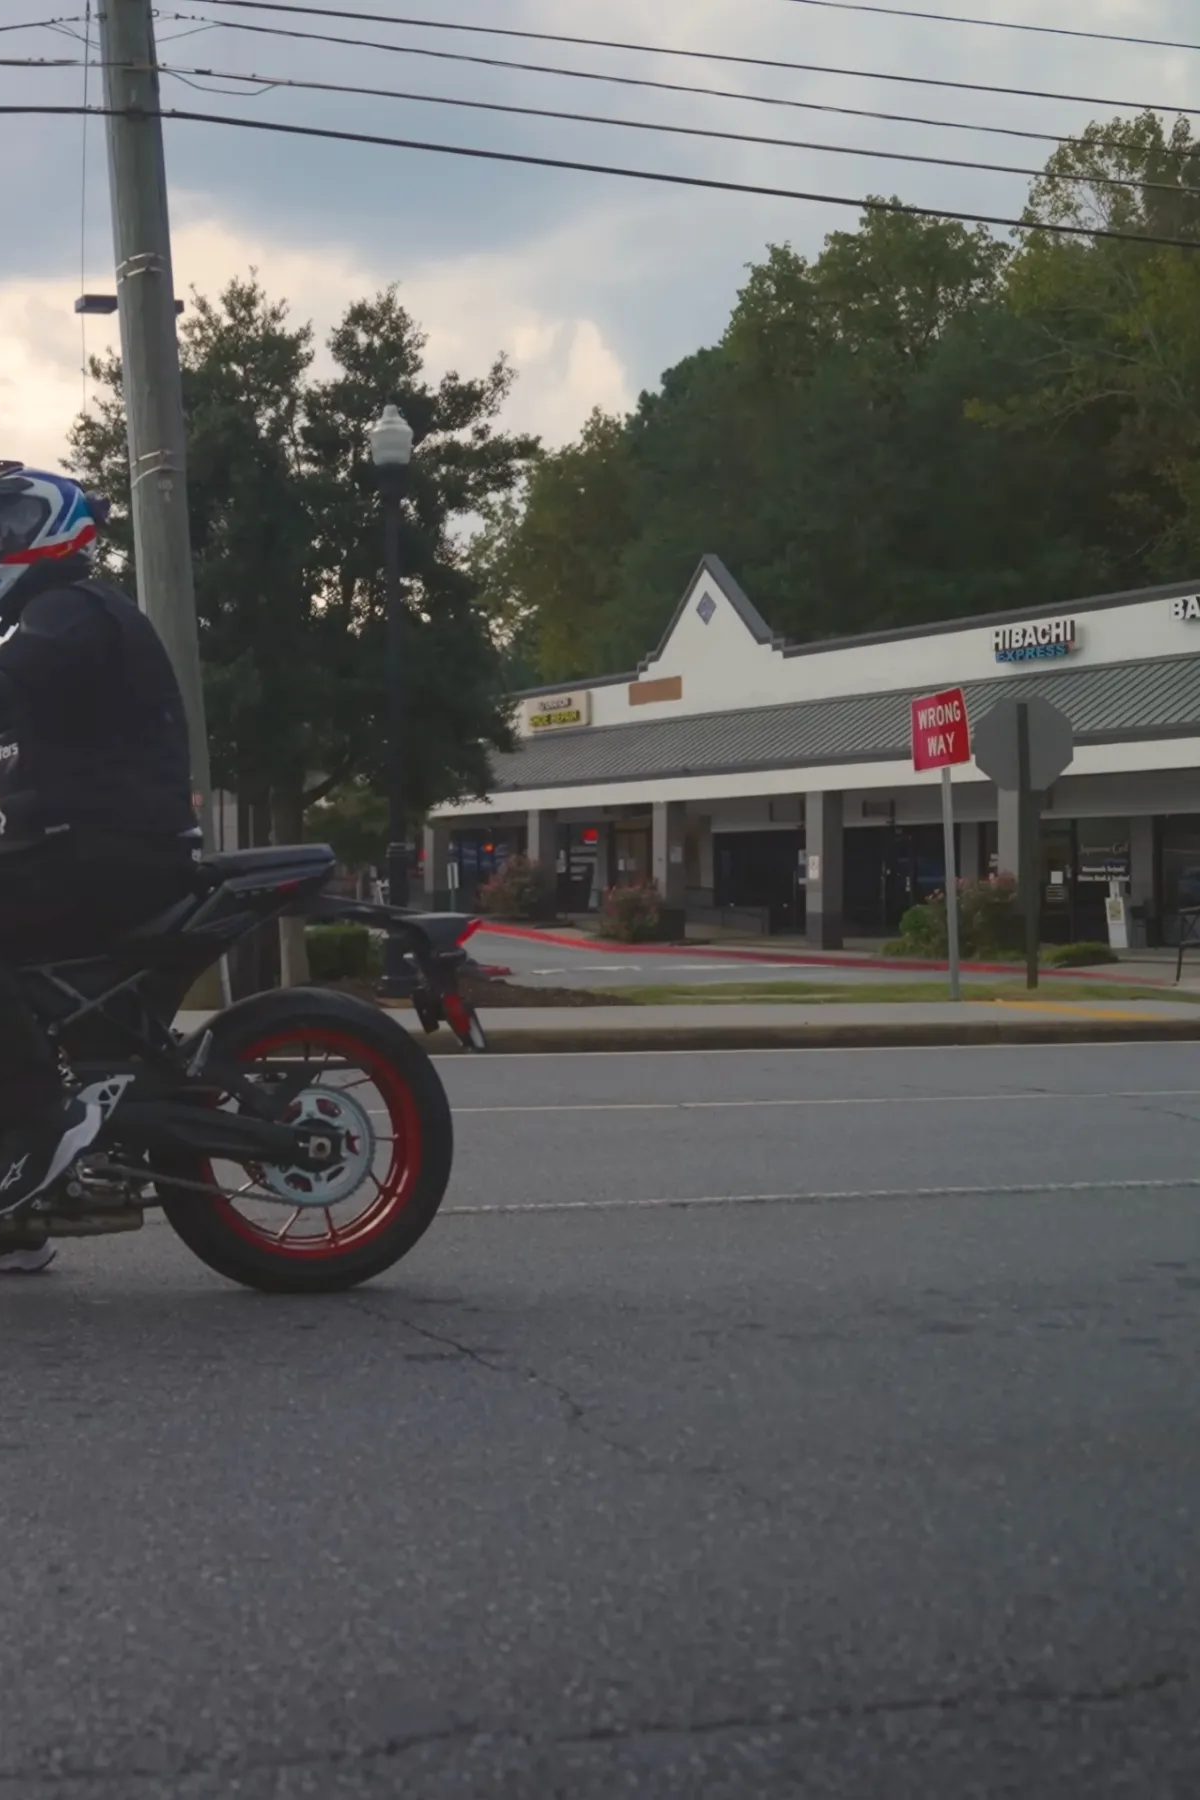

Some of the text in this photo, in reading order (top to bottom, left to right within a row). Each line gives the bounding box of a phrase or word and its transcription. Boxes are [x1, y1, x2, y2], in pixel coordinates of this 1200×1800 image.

[992, 620, 1076, 651] HIBACHI
[996, 643, 1066, 663] EXPRESS
[918, 700, 961, 730] WRONG
[927, 732, 955, 757] WAY
